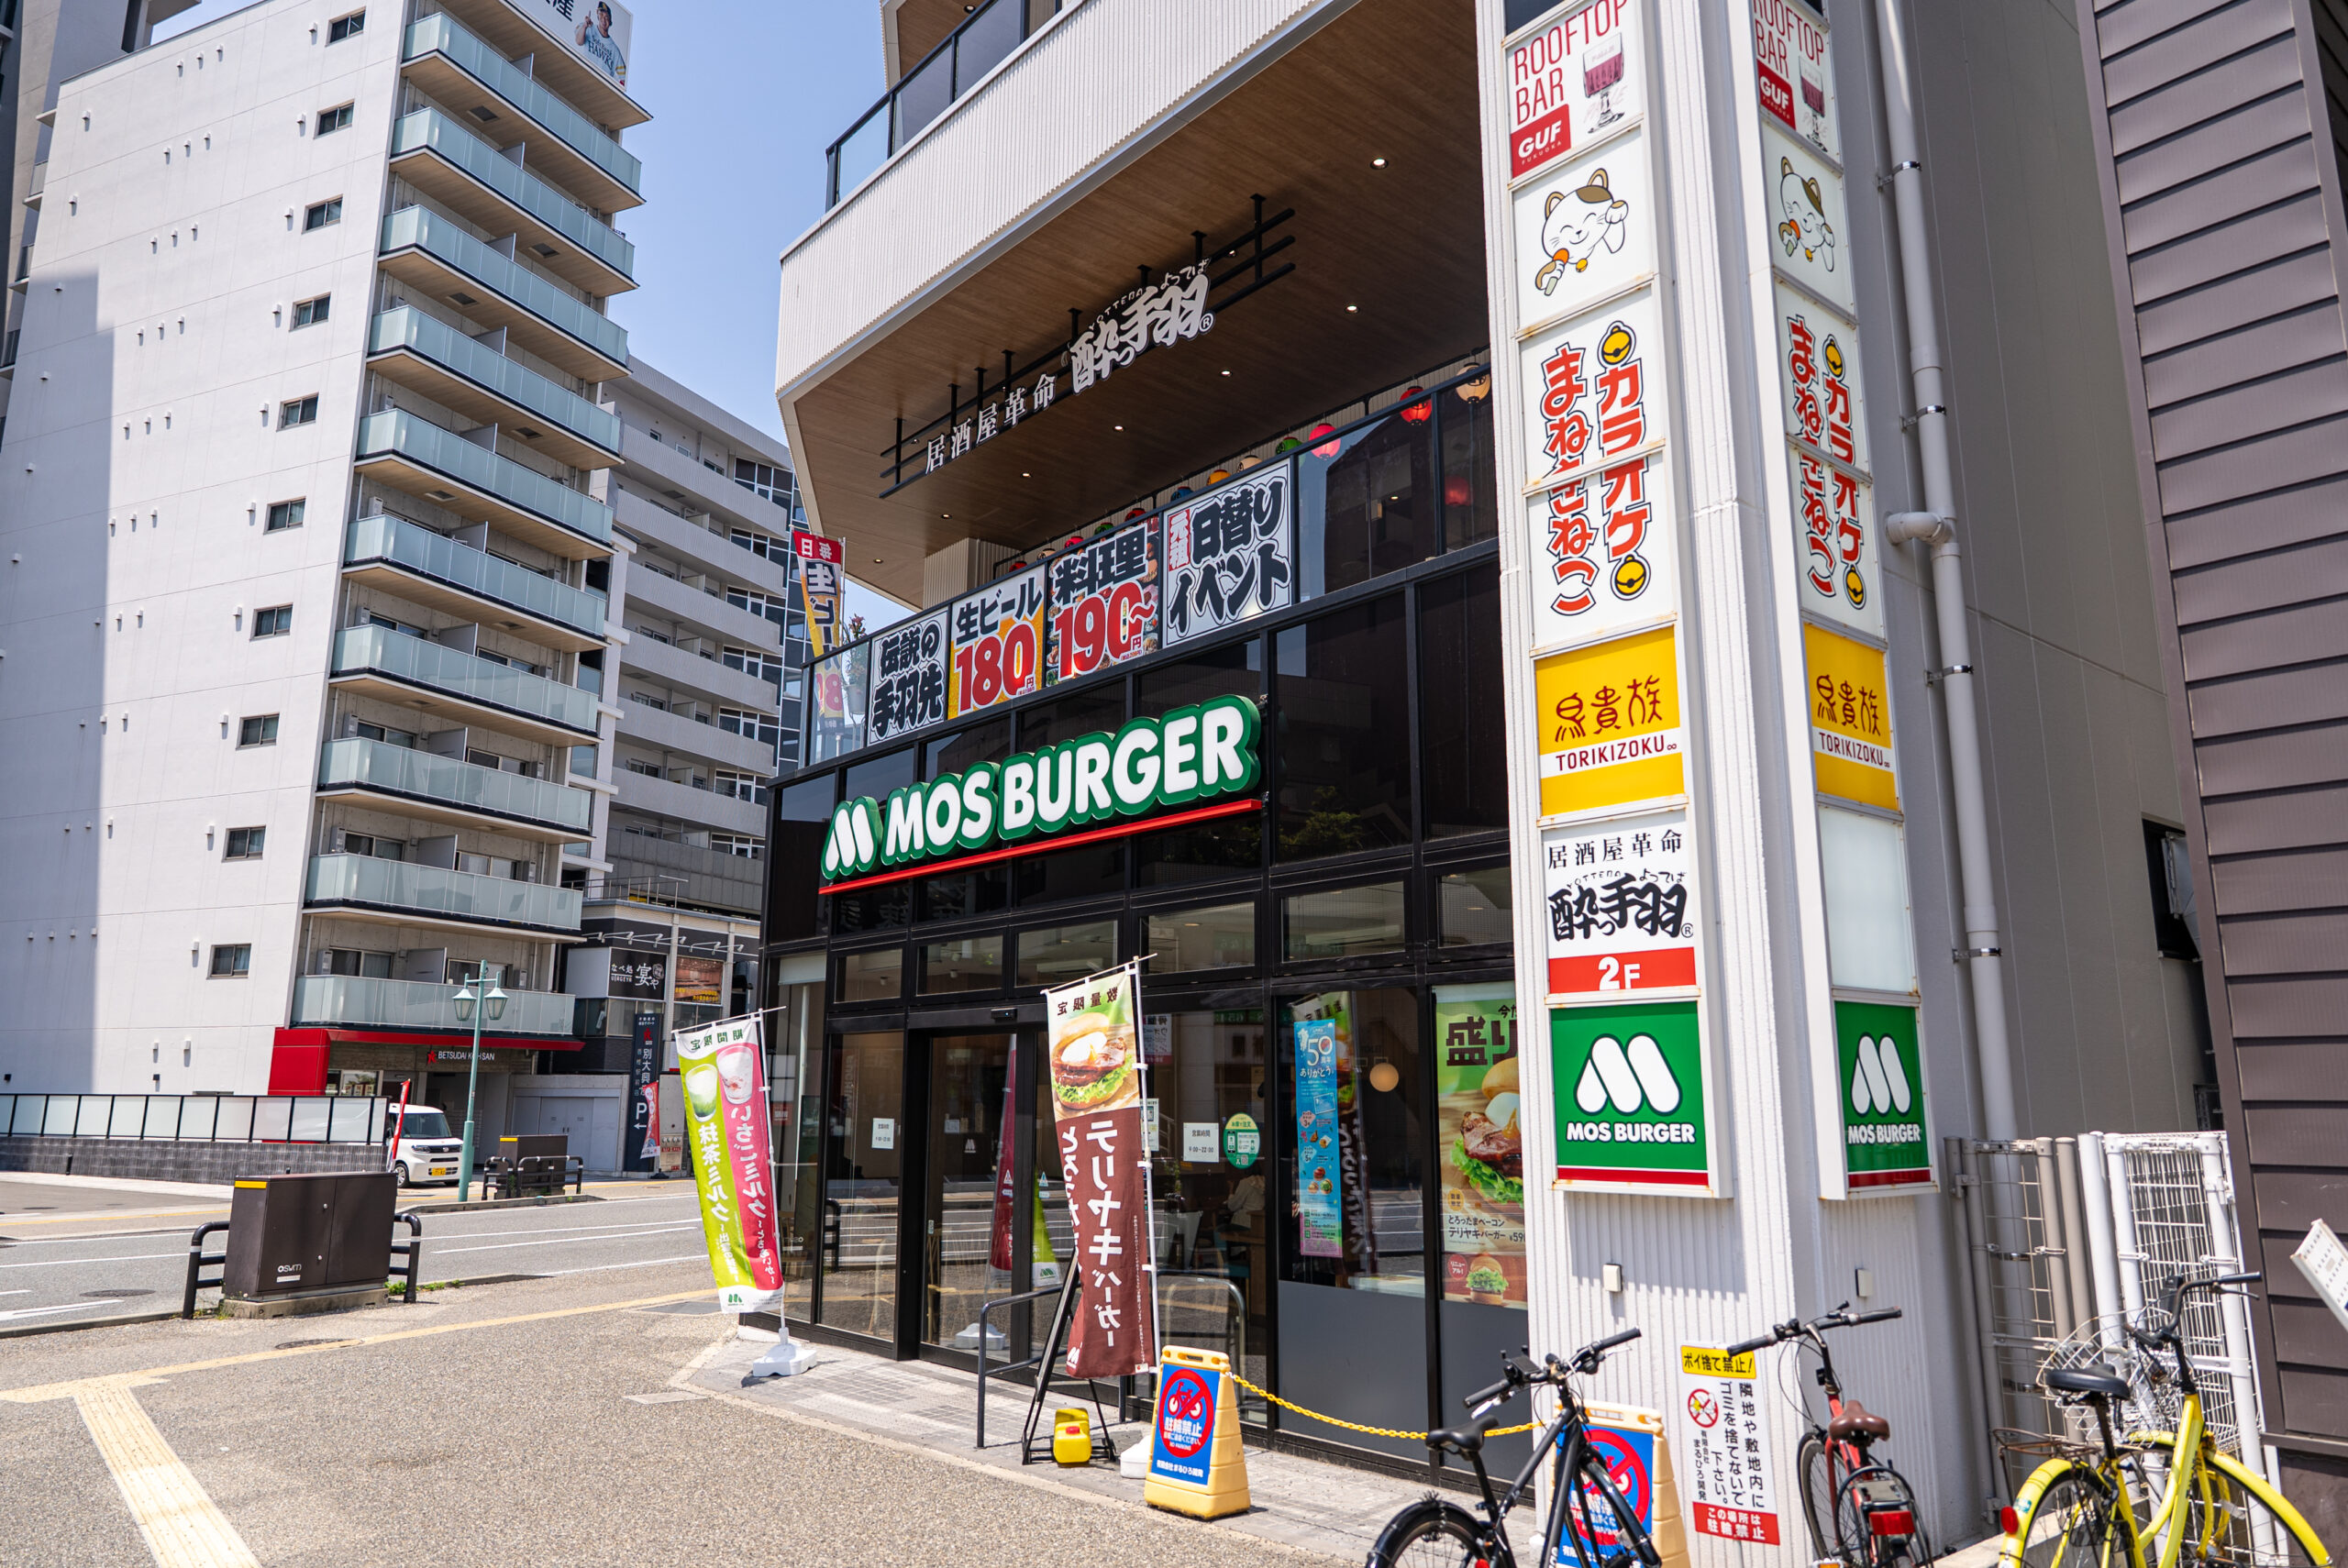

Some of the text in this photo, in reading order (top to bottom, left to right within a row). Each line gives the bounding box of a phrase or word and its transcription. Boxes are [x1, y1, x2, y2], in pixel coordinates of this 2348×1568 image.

[1514, 0, 1627, 85] ROOFTOP
[1755, 19, 1789, 79] BAR
[1516, 67, 1564, 126] BAR
[1759, 76, 1789, 110] GUF
[1518, 120, 1562, 159] GUF
[1522, 141, 1562, 165] FUKUOKA
[925, 373, 1057, 475] 居酒屋革命
[1541, 343, 1599, 615] まねきねこ
[1596, 359, 1650, 562] カラオケ
[1823, 372, 1861, 564] カラオケ
[1169, 512, 1189, 569] 元祖
[1191, 480, 1284, 566] 日替り
[1052, 529, 1146, 605] 料理
[1168, 542, 1290, 635] イベント
[956, 577, 1042, 643] 生ビール
[878, 618, 939, 678] 伝説の
[872, 660, 944, 738] 手羽先
[1556, 734, 1665, 771] TORIKIZOKU
[1819, 732, 1884, 767] TORIKIZOKU
[885, 770, 991, 856] MOS
[1004, 705, 1245, 830] BURGER
[1548, 829, 1682, 869] 居酒屋革命
[1639, 868, 1686, 883] よってば
[1598, 956, 1640, 990] 2F
[438, 1051, 467, 1060] BETSUDAI
[1307, 1035, 1333, 1066] 50
[637, 1102, 647, 1120] P
[1567, 1121, 1695, 1143] MOS BURGER
[1848, 1123, 1921, 1143] MOS BURGER
[1448, 1215, 1504, 1227] とろったまベーコン
[1448, 1227, 1506, 1240] テリヤキバーガー
[1693, 1439, 1707, 1501] まるひろ開発
[1720, 1381, 1744, 1507] ゴミを捨てないで
[1739, 1383, 1765, 1507] 隣地や敷地内に
[1711, 1452, 1728, 1505] 下さい。
[1707, 1518, 1766, 1540] 駐輪禁止
[1708, 1507, 1761, 1525] この場所は
